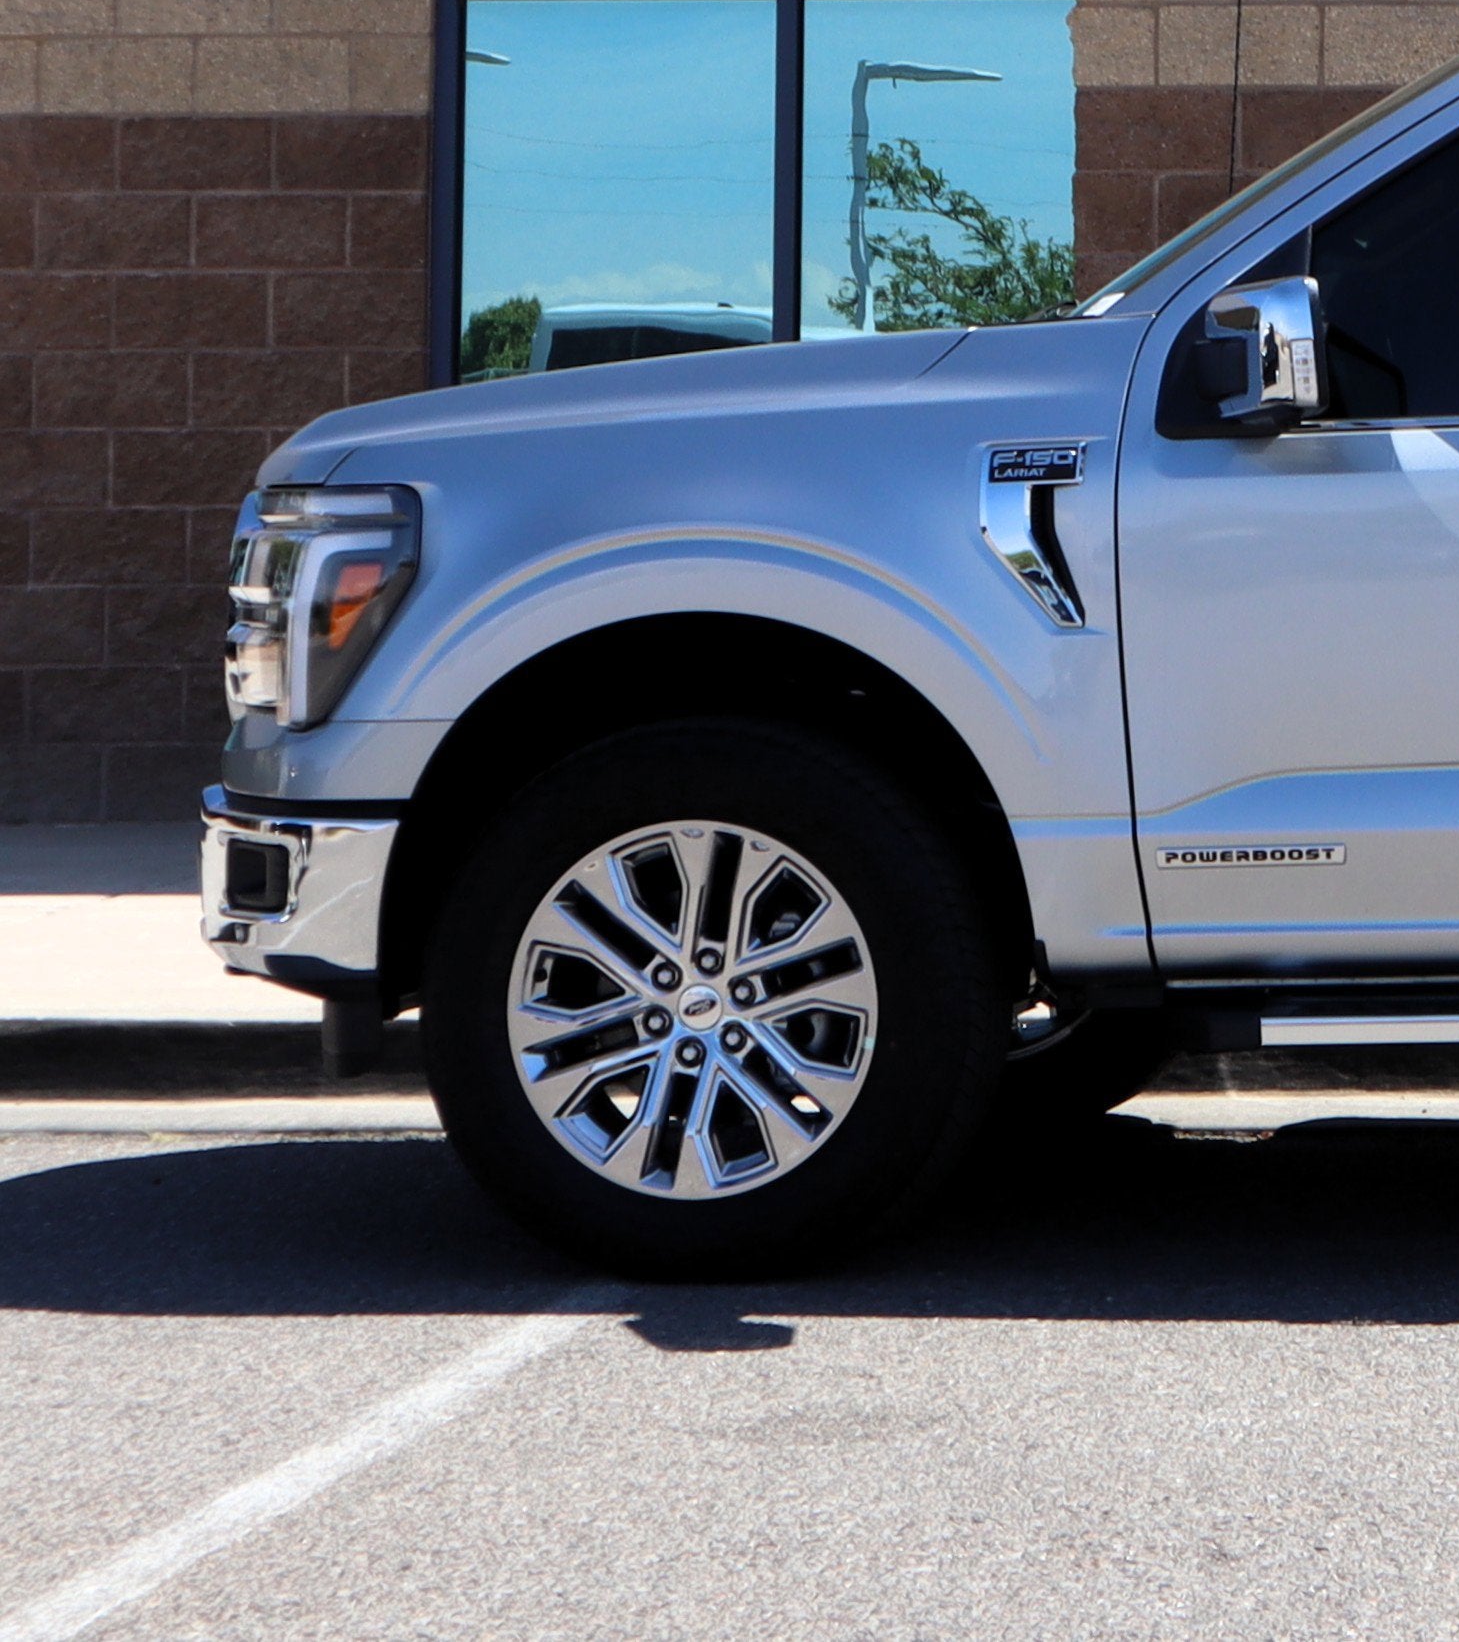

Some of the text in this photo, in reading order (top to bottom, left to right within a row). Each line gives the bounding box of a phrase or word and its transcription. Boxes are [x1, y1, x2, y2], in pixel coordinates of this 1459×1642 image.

[992, 449, 1075, 467] F-150
[994, 468, 1046, 478] LARIAT
[1164, 848, 1335, 864] POWERBOOST
